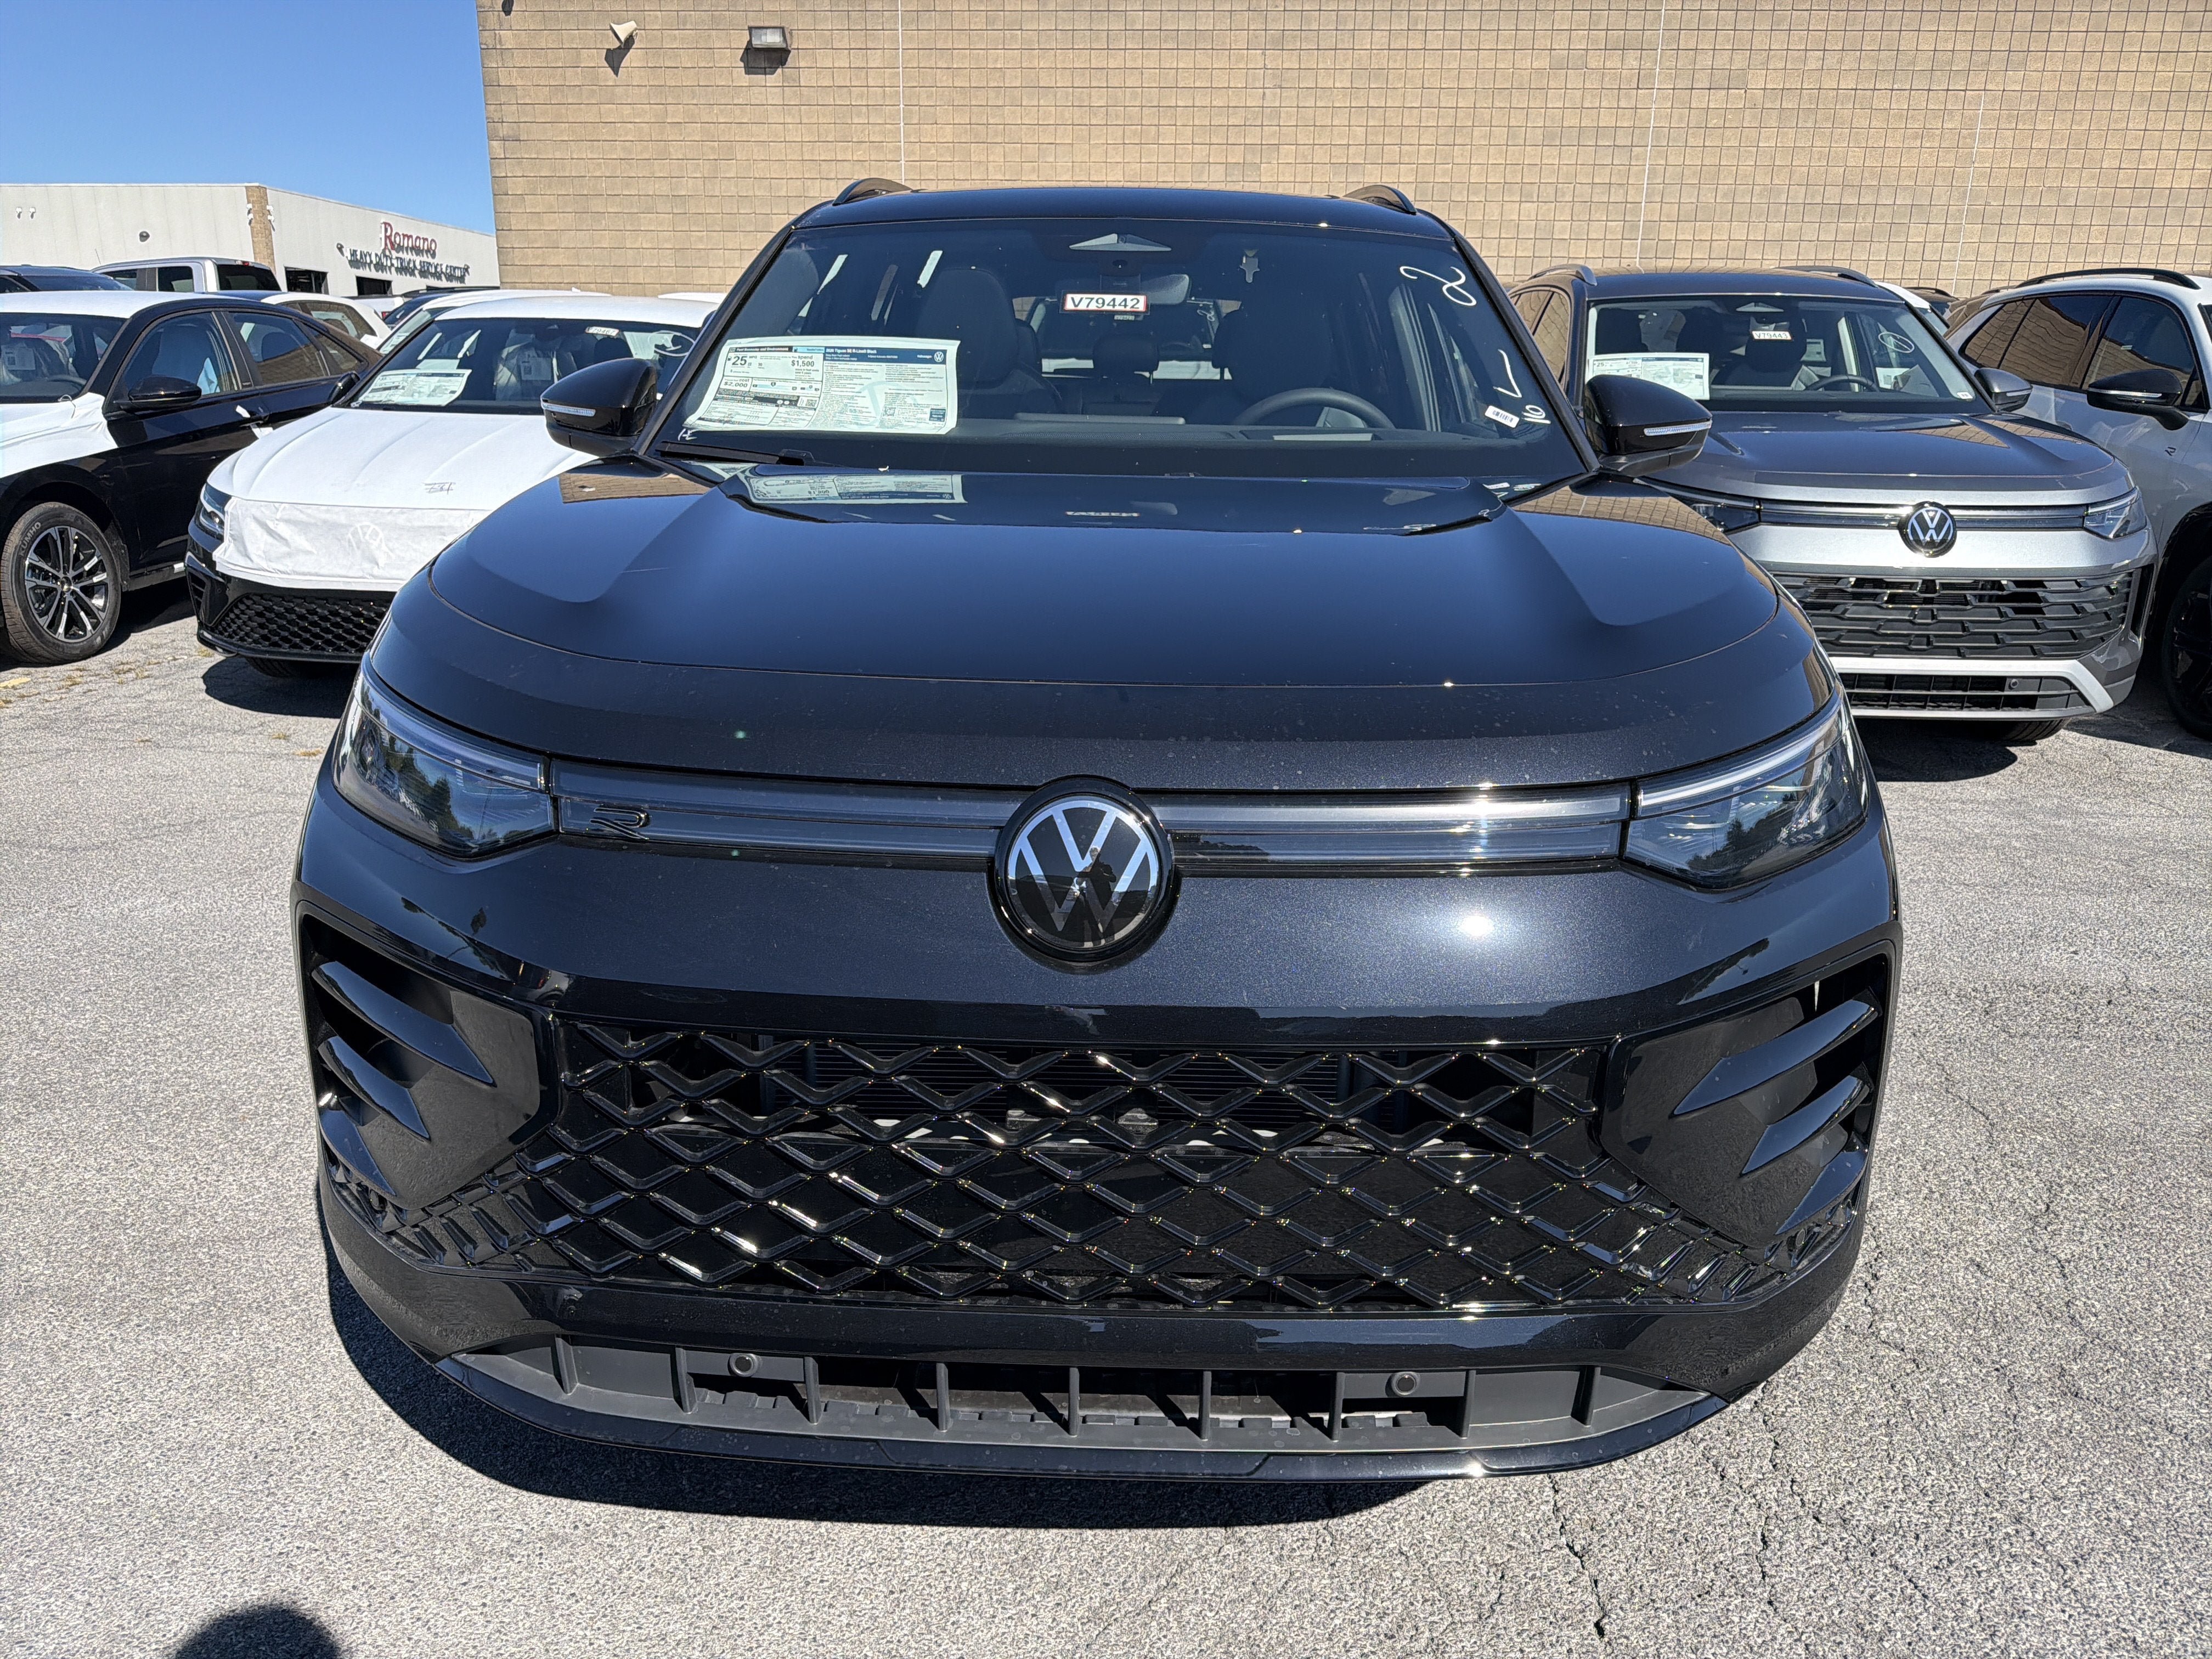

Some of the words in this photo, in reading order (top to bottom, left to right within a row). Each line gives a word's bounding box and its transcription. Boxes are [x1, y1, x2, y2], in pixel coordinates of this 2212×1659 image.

[380, 221, 437, 251] Romano
[349, 248, 373, 263] HEAVY
[395, 256, 416, 270] TRUCK
[1070, 296, 1140, 309] V79442
[732, 356, 747, 366] 25
[19, 522, 41, 556] KUMHO
[1908, 506, 1954, 551] VW
[1008, 798, 1159, 948] VW
